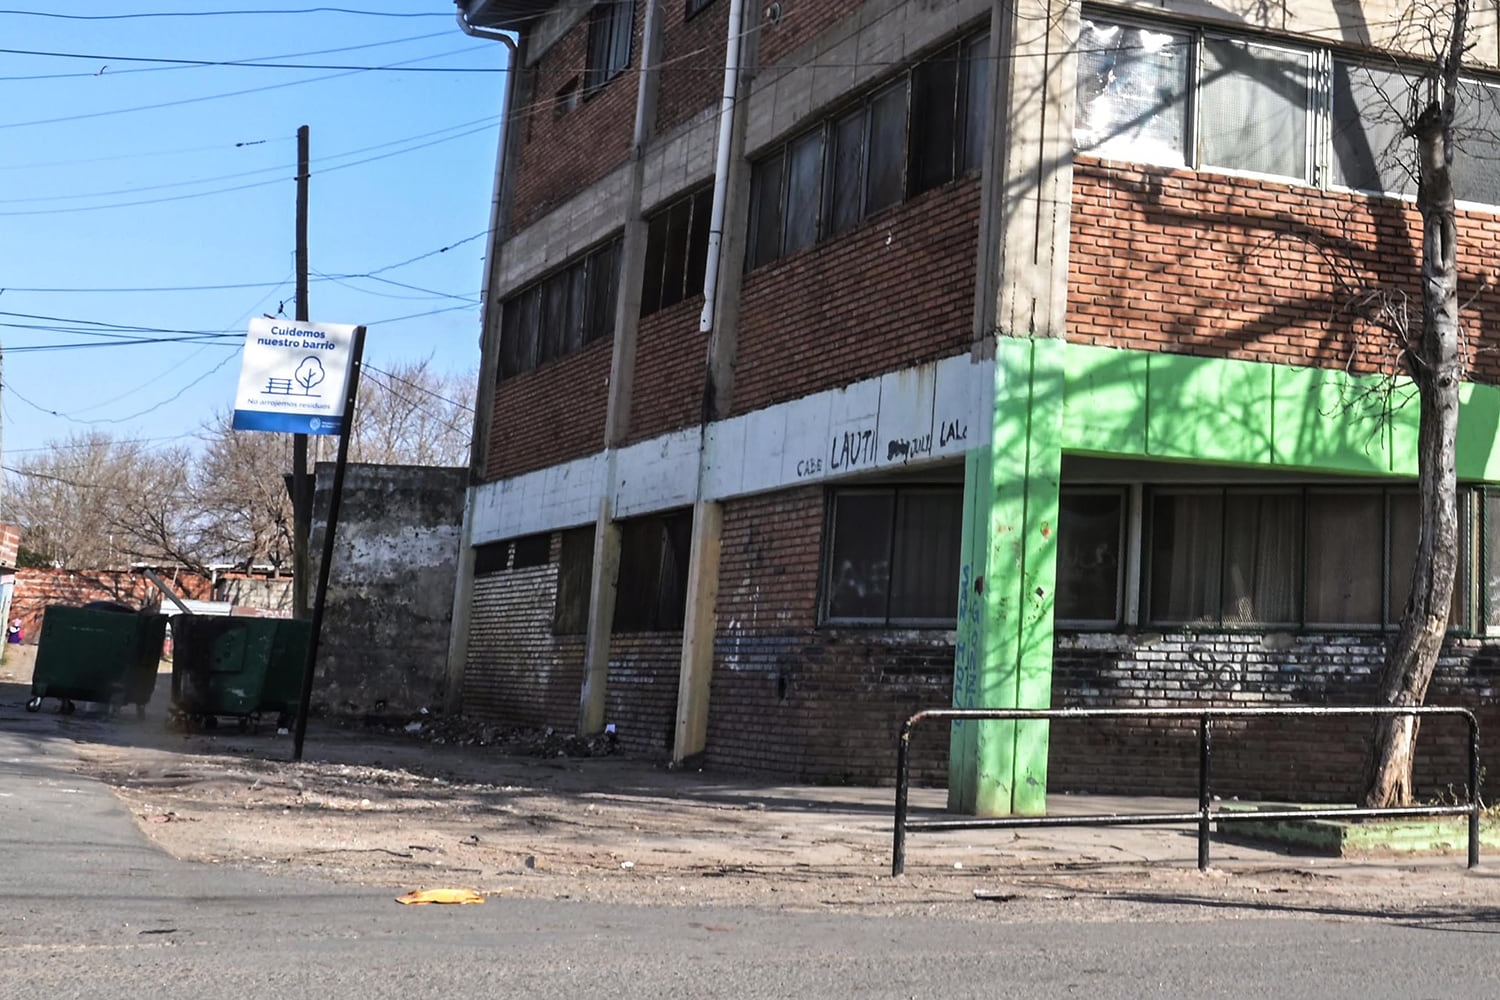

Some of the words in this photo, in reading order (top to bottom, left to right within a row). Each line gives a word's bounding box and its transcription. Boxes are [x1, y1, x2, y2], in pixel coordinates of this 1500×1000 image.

[271, 326, 325, 339] Cuidemos
[257, 337, 300, 348] nuestro
[302, 339, 336, 351] barrio
[259, 399, 297, 409] arrojemos
